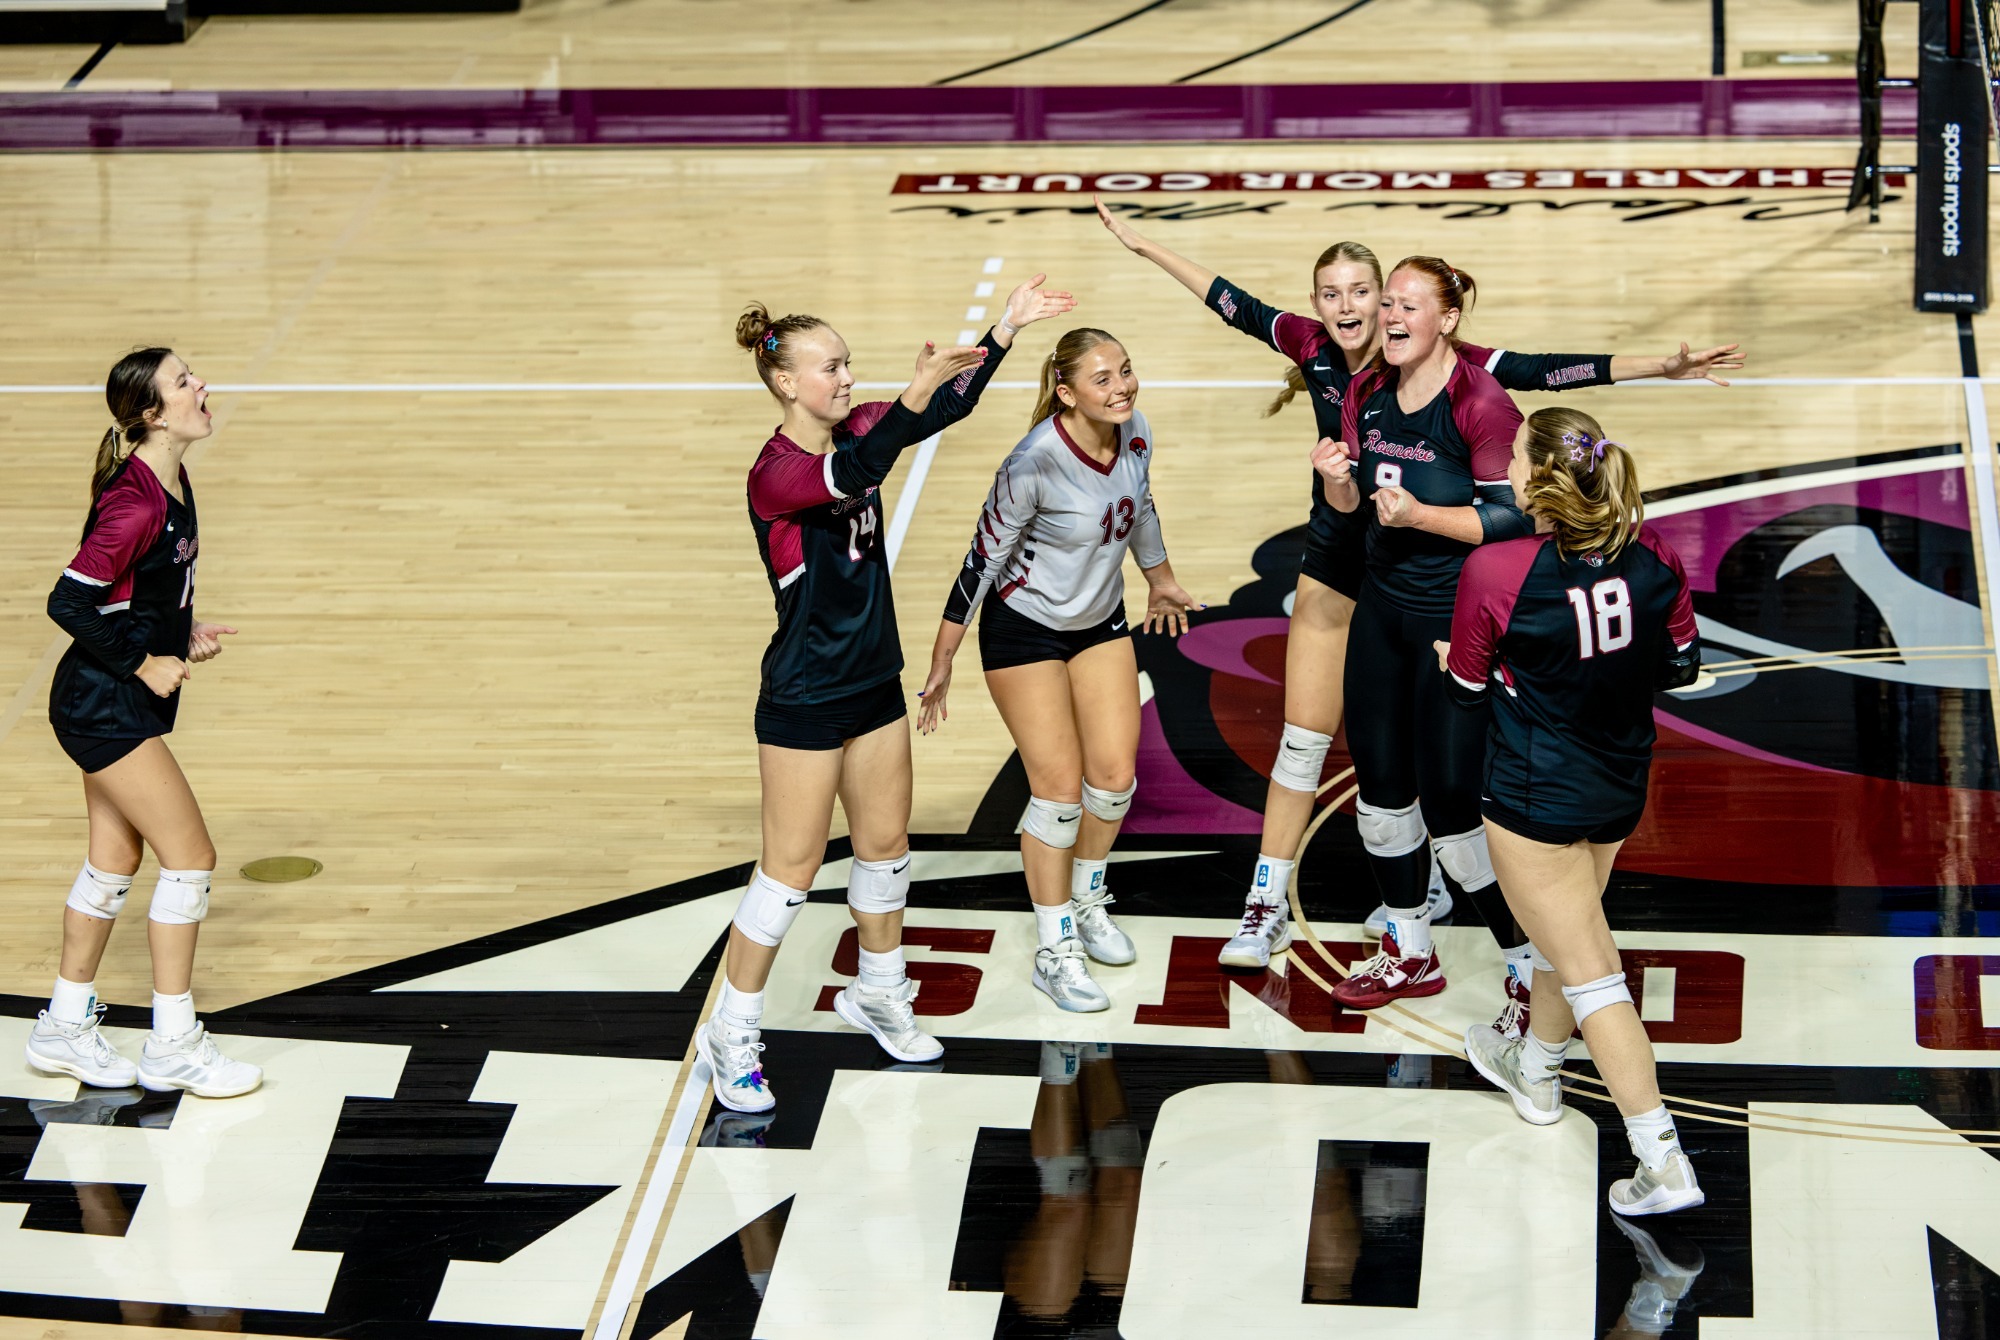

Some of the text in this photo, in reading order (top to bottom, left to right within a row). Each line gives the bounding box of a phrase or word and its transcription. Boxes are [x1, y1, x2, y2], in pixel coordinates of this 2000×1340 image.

[919, 174, 1210, 192] COURT
[1240, 172, 1450, 190] MOIR
[1940, 123, 1962, 257] sports imports
[1545, 362, 1597, 387] MAROONS
[1363, 428, 1436, 462] Roanoke
[848, 504, 878, 563] 14
[1099, 495, 1136, 547] 13
[1566, 576, 1633, 660] 18
